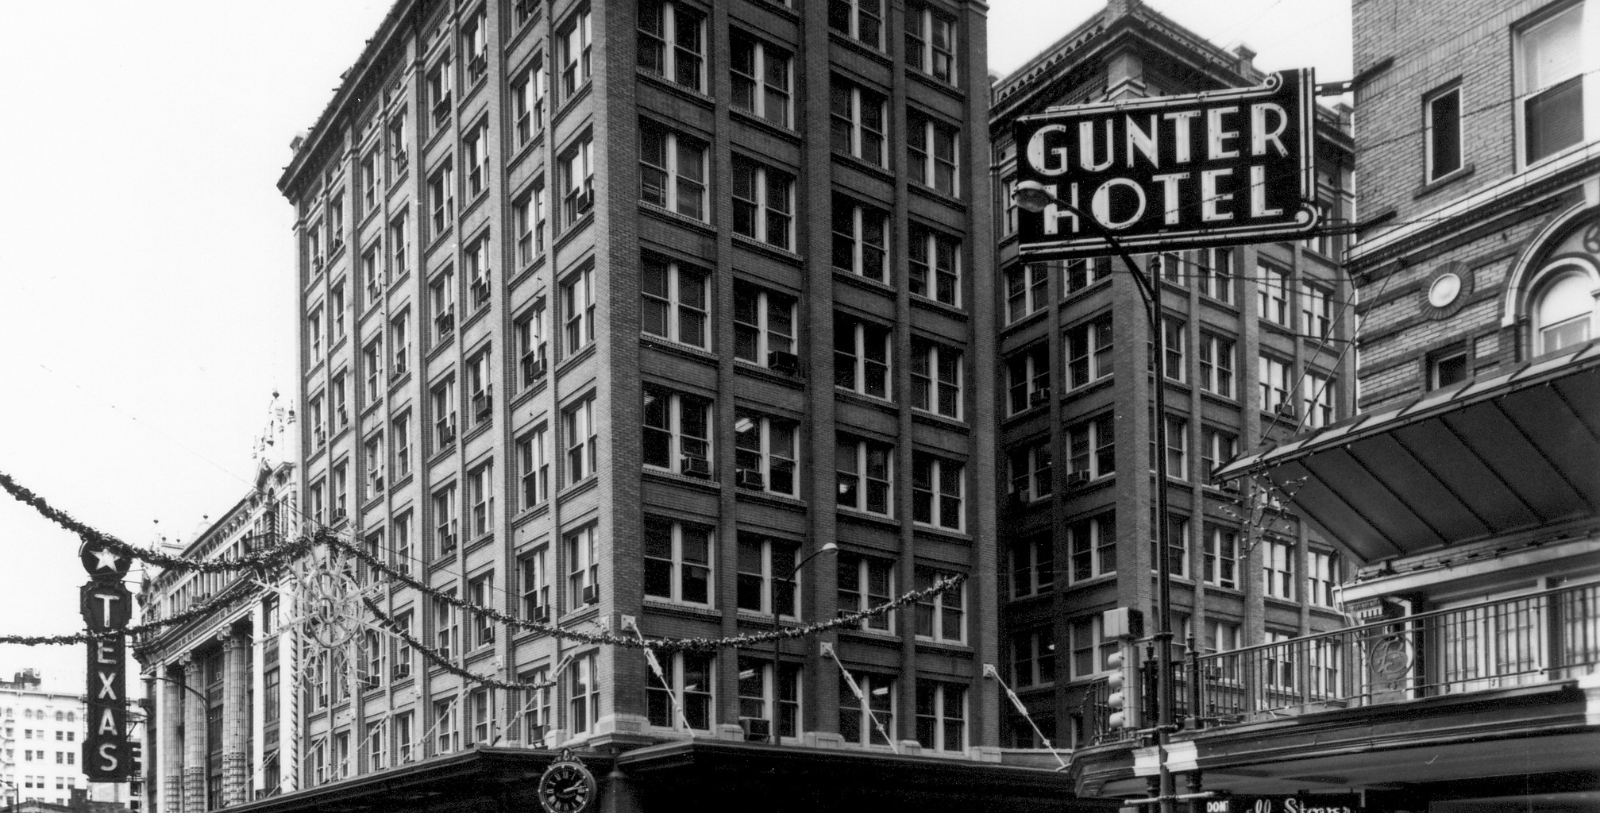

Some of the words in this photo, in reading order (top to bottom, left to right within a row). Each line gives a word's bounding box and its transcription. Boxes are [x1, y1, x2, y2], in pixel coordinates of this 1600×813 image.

[1026, 102, 1289, 176] GUNTER
[1043, 165, 1284, 236] HOTEL
[94, 593, 120, 772] TEXAS
